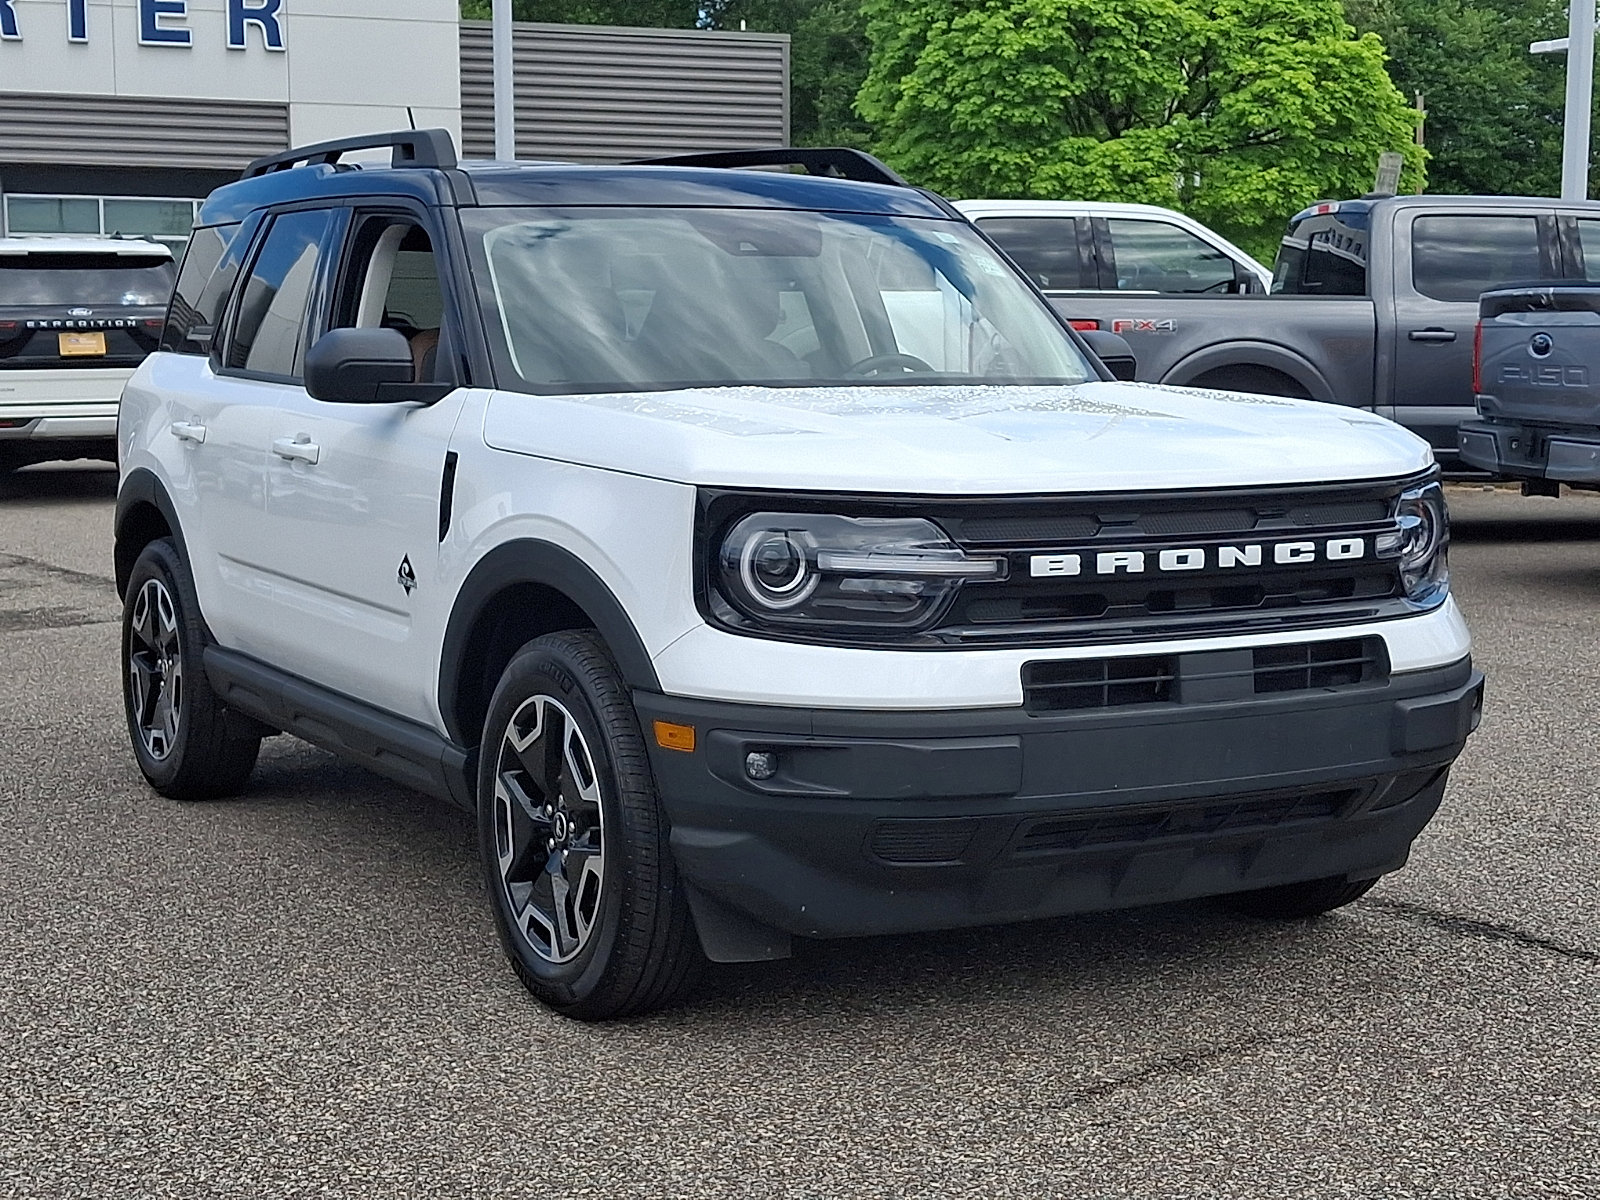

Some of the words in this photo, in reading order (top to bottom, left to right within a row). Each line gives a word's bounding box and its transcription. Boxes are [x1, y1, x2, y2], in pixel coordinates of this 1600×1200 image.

[26, 320, 136, 328] EXPEDITION
[1112, 319, 1177, 334] FX4
[1498, 363, 1588, 387] F-150
[1030, 537, 1365, 578] BRONCO
